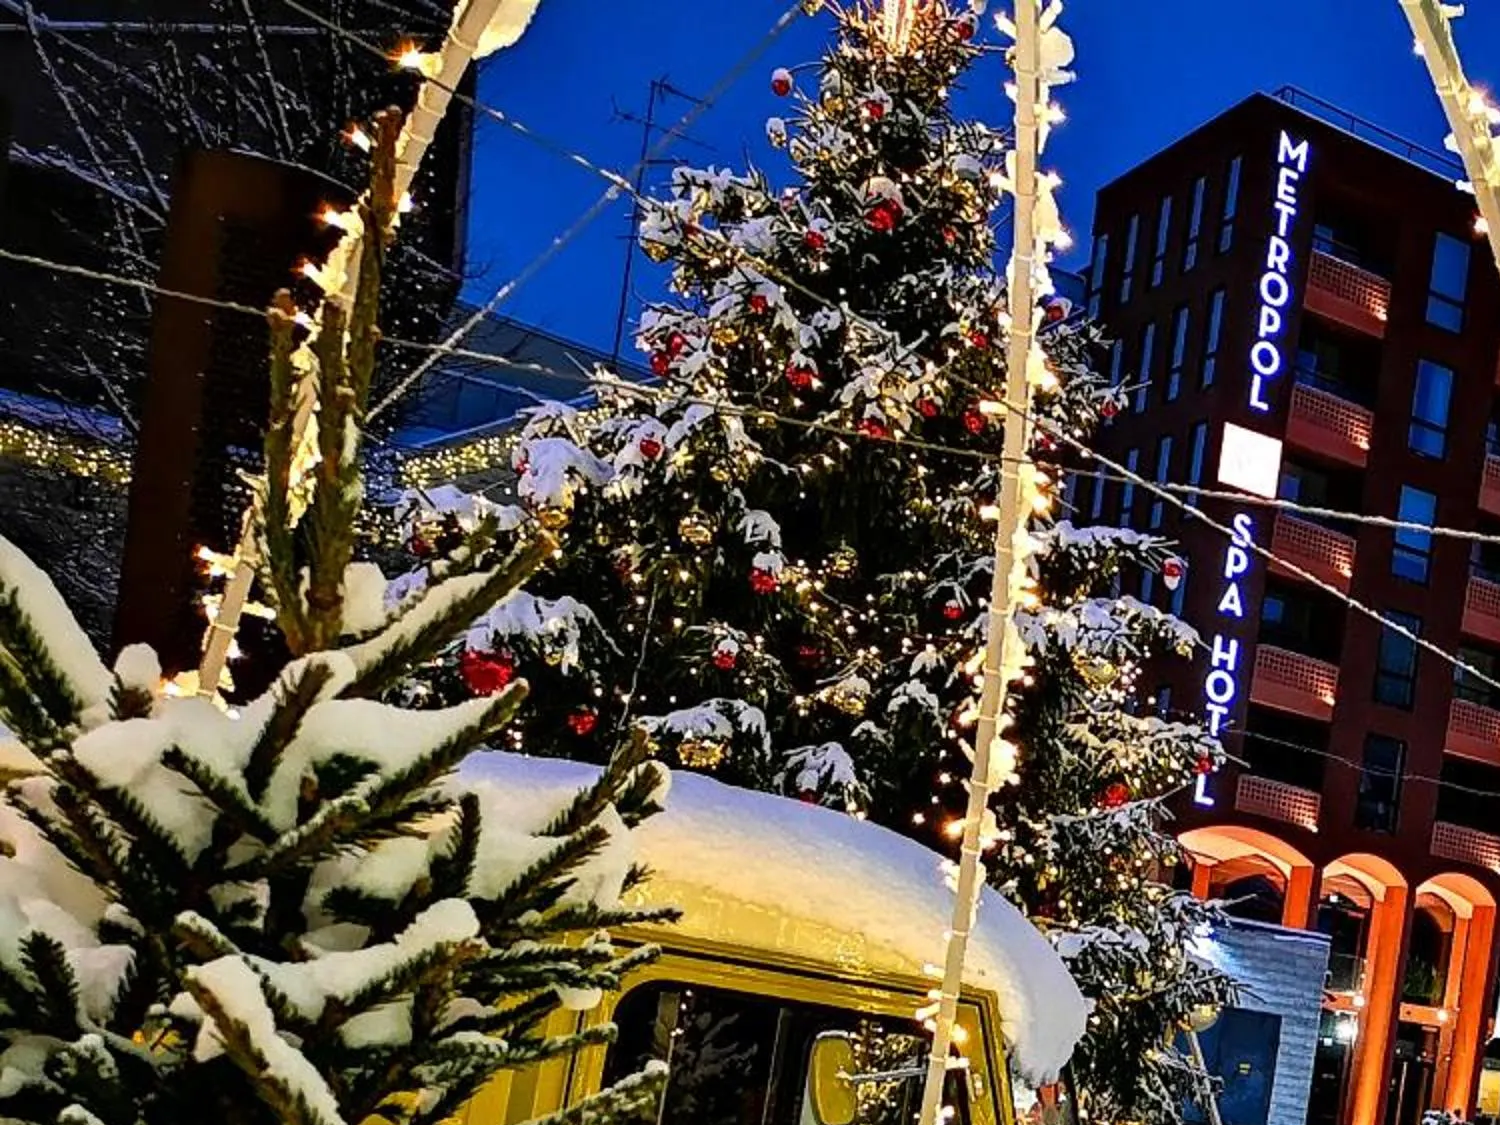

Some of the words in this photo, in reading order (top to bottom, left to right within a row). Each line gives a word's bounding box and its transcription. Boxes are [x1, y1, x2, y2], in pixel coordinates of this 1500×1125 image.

[1249, 130, 1308, 411] METROPOL
[1218, 513, 1253, 617] SPA
[1195, 634, 1238, 806] HOTL
